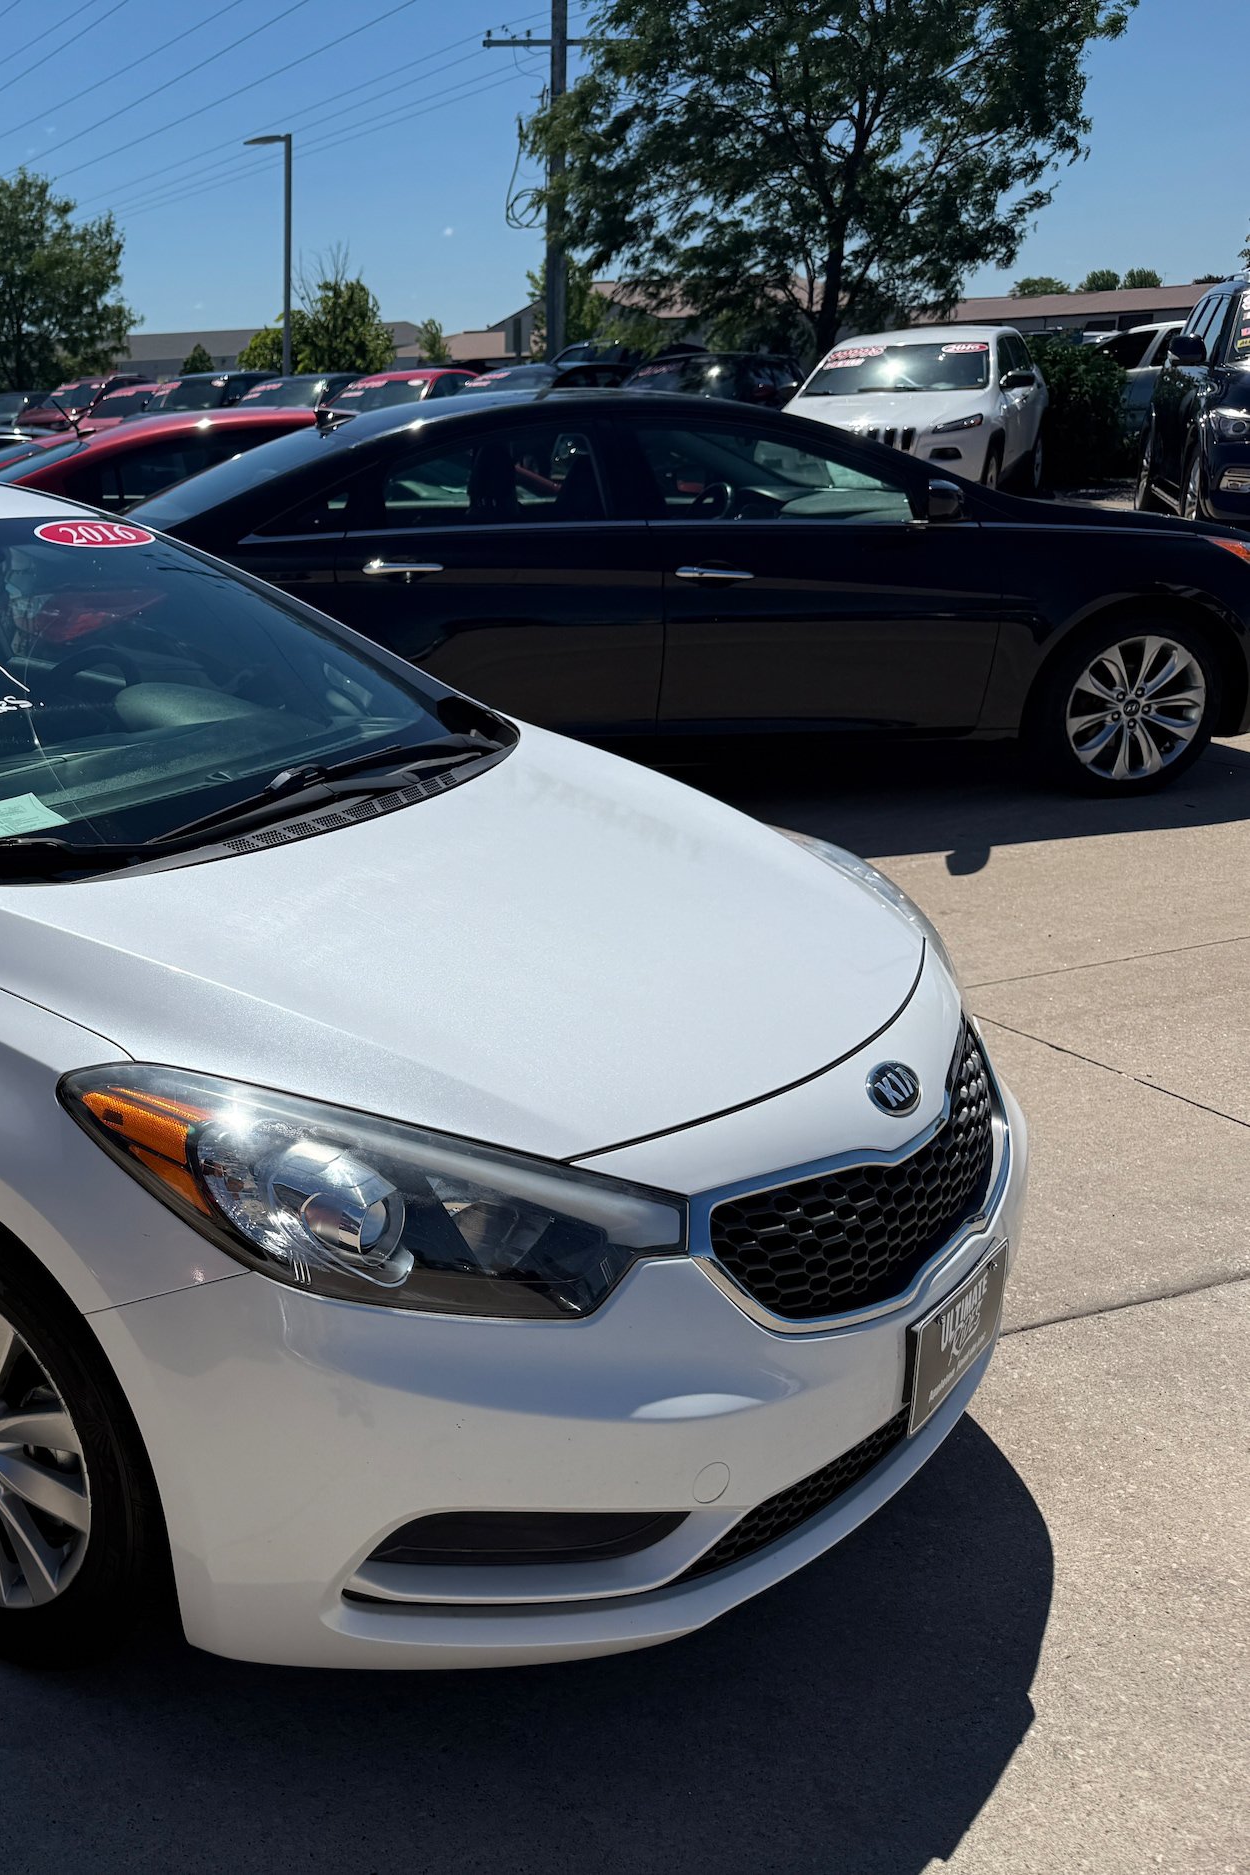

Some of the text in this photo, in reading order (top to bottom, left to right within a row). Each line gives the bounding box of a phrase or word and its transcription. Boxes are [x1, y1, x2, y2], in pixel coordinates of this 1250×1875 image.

[58, 524, 137, 544] 2016
[874, 1066, 919, 1108] KIA
[940, 1271, 989, 1352] ULTIMATE
